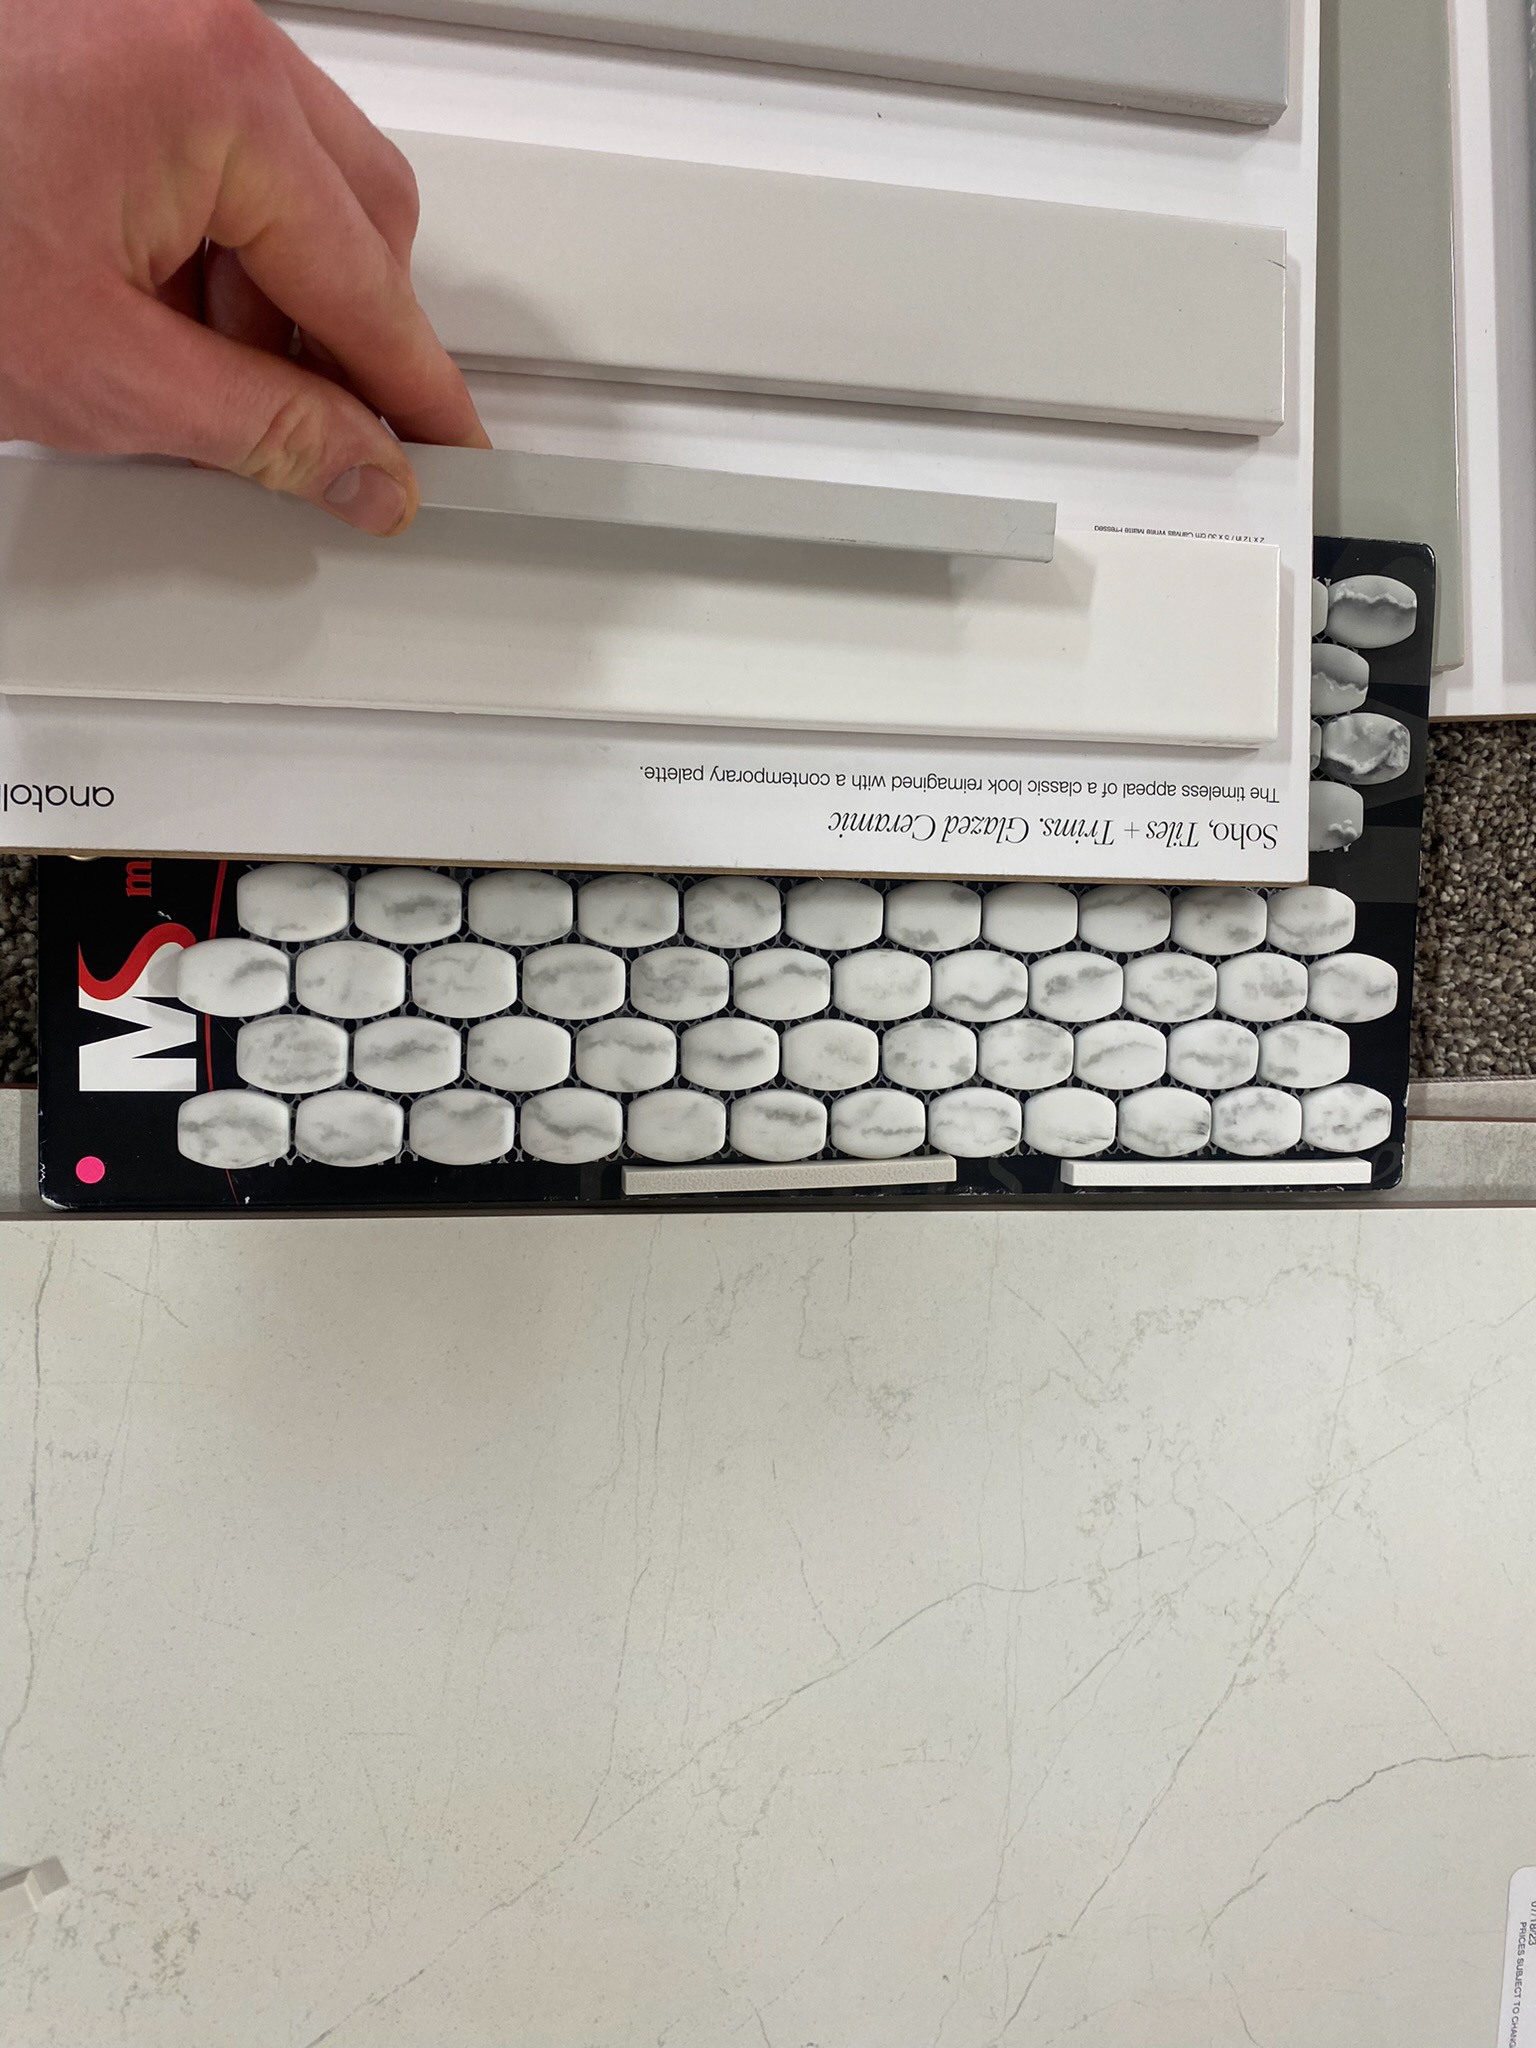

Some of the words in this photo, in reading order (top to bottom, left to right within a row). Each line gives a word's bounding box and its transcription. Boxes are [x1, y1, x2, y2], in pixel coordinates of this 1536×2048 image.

[1167, 530, 1194, 538] Canvas
[1243, 535, 1252, 543] 12
[639, 764, 705, 785] palette.
[709, 765, 831, 788] contemporary
[835, 773, 847, 787] a
[851, 774, 887, 791] with
[892, 772, 983, 794] reimagined
[987, 778, 1022, 796] look
[1028, 779, 1083, 798] classic
[1086, 781, 1098, 795] a
[1102, 782, 1118, 799] of
[1123, 780, 1177, 799] appeal
[1182, 784, 1246, 803] timeless
[1249, 786, 1280, 804] The
[827, 812, 937, 842] Ceramic
[941, 815, 1030, 844] Glazed
[1039, 817, 1115, 846] Trims.
[1123, 821, 1141, 839] +
[1145, 820, 1200, 848] Tiles
[1208, 819, 1278, 850] Soho,
[1517, 1921, 1527, 1956] PRICES
[1514, 1958, 1525, 1999] SUBJECT
[1512, 2000, 1521, 2015] TO
